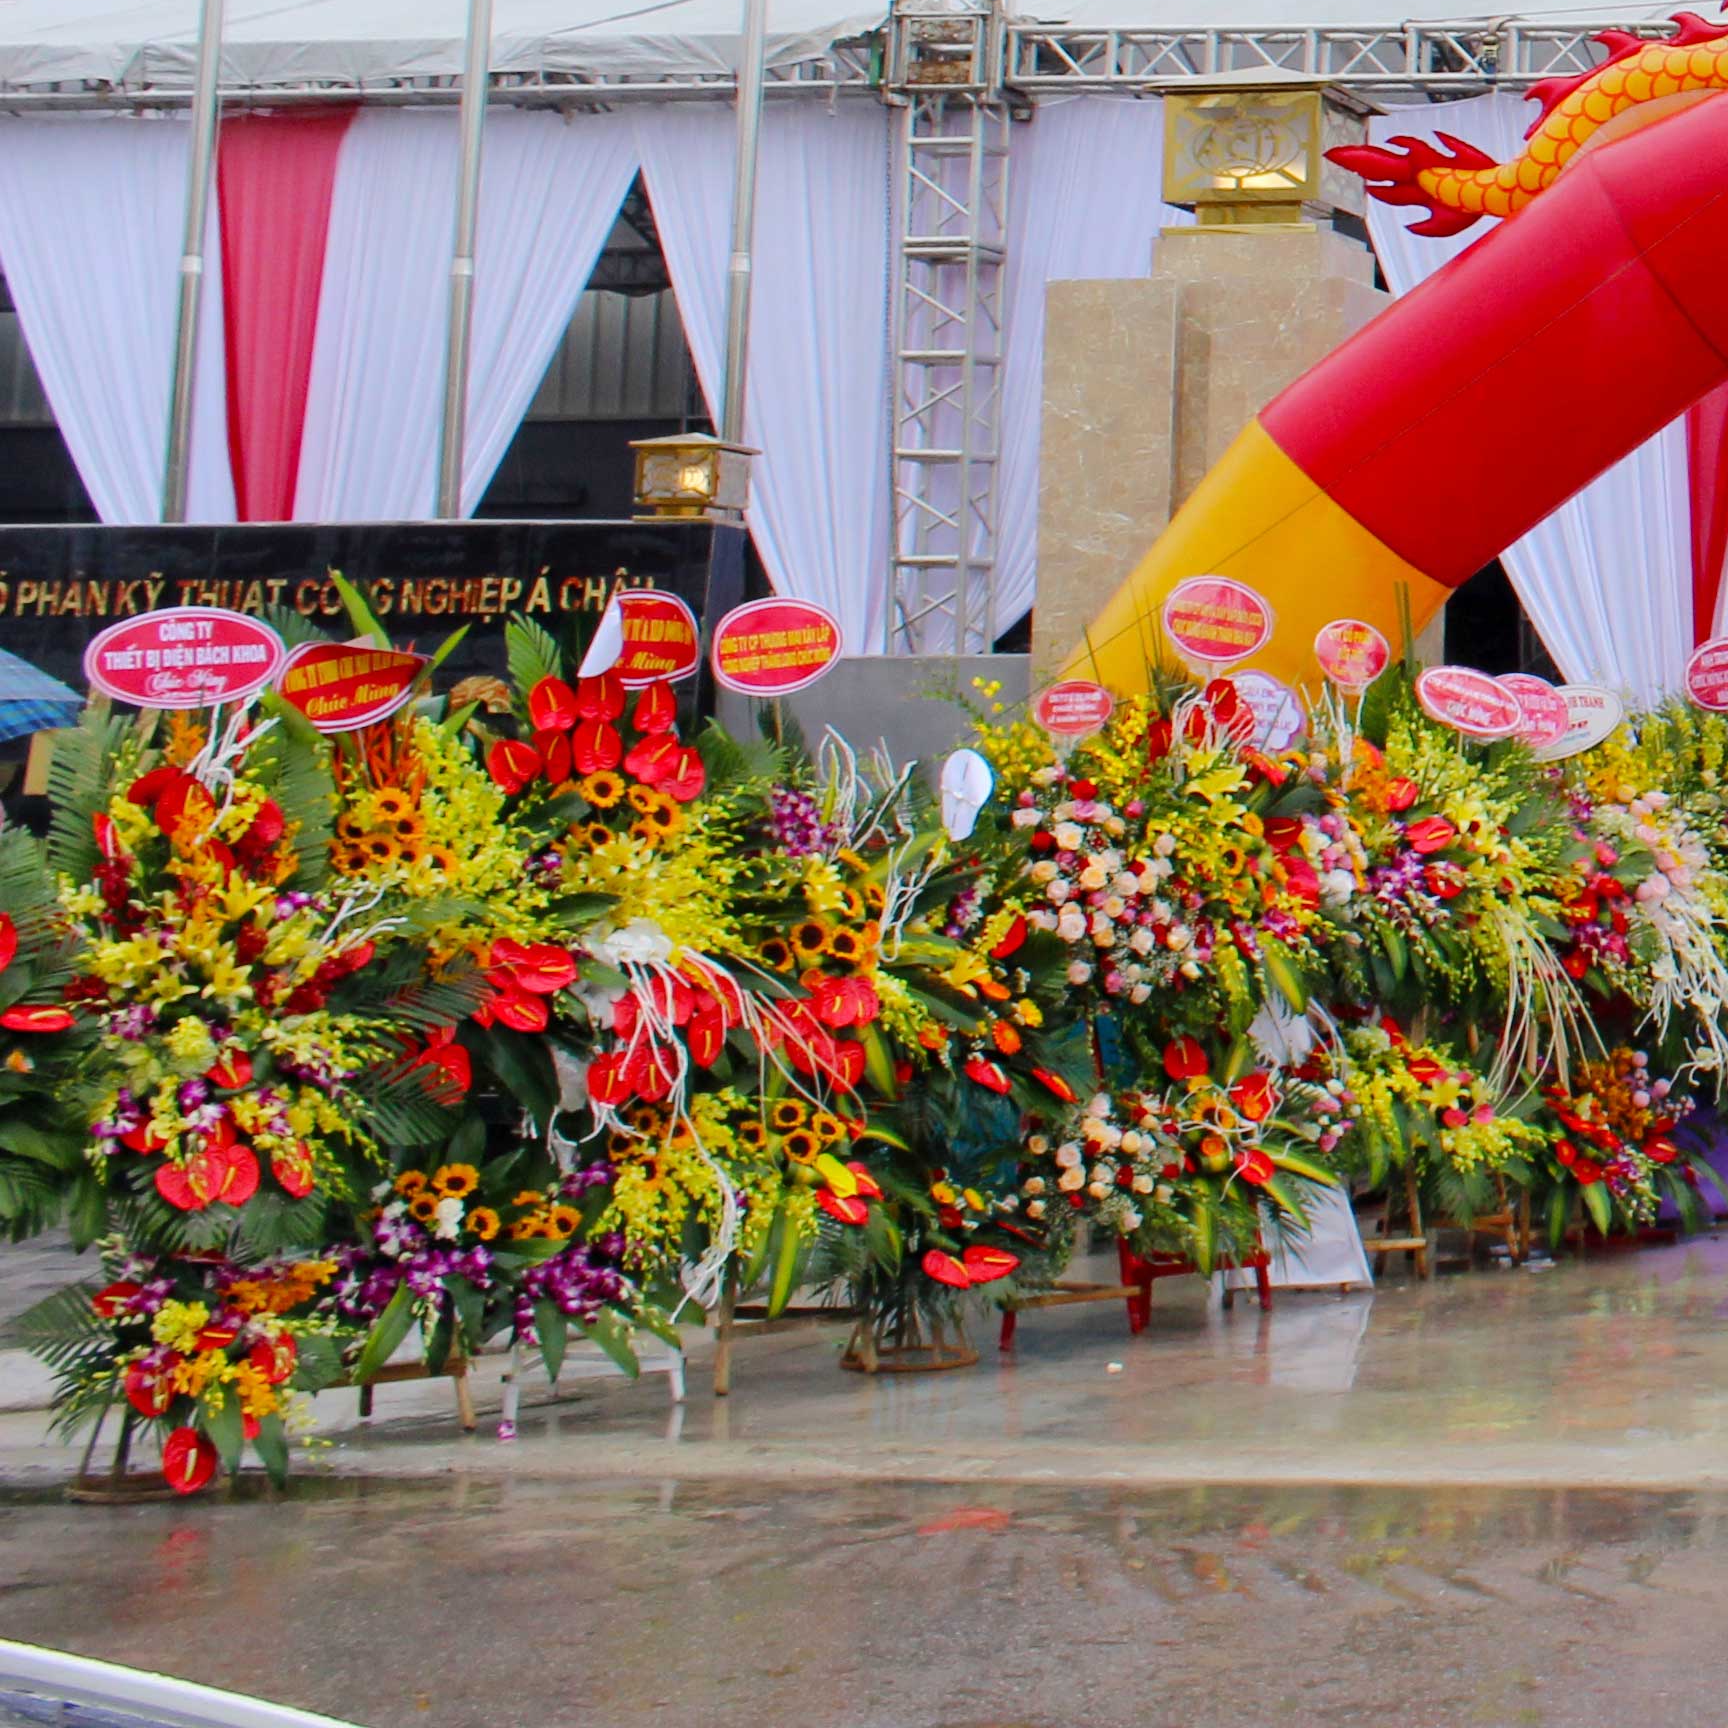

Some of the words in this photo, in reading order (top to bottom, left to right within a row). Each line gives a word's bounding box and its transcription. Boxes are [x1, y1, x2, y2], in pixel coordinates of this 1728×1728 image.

[525, 566, 551, 612] Á
[160, 619, 195, 641] CÔNG
[199, 621, 213, 640] TY
[105, 643, 143, 670] THIẾT
[146, 649, 161, 671] BỊ
[233, 644, 267, 663] KHOA
